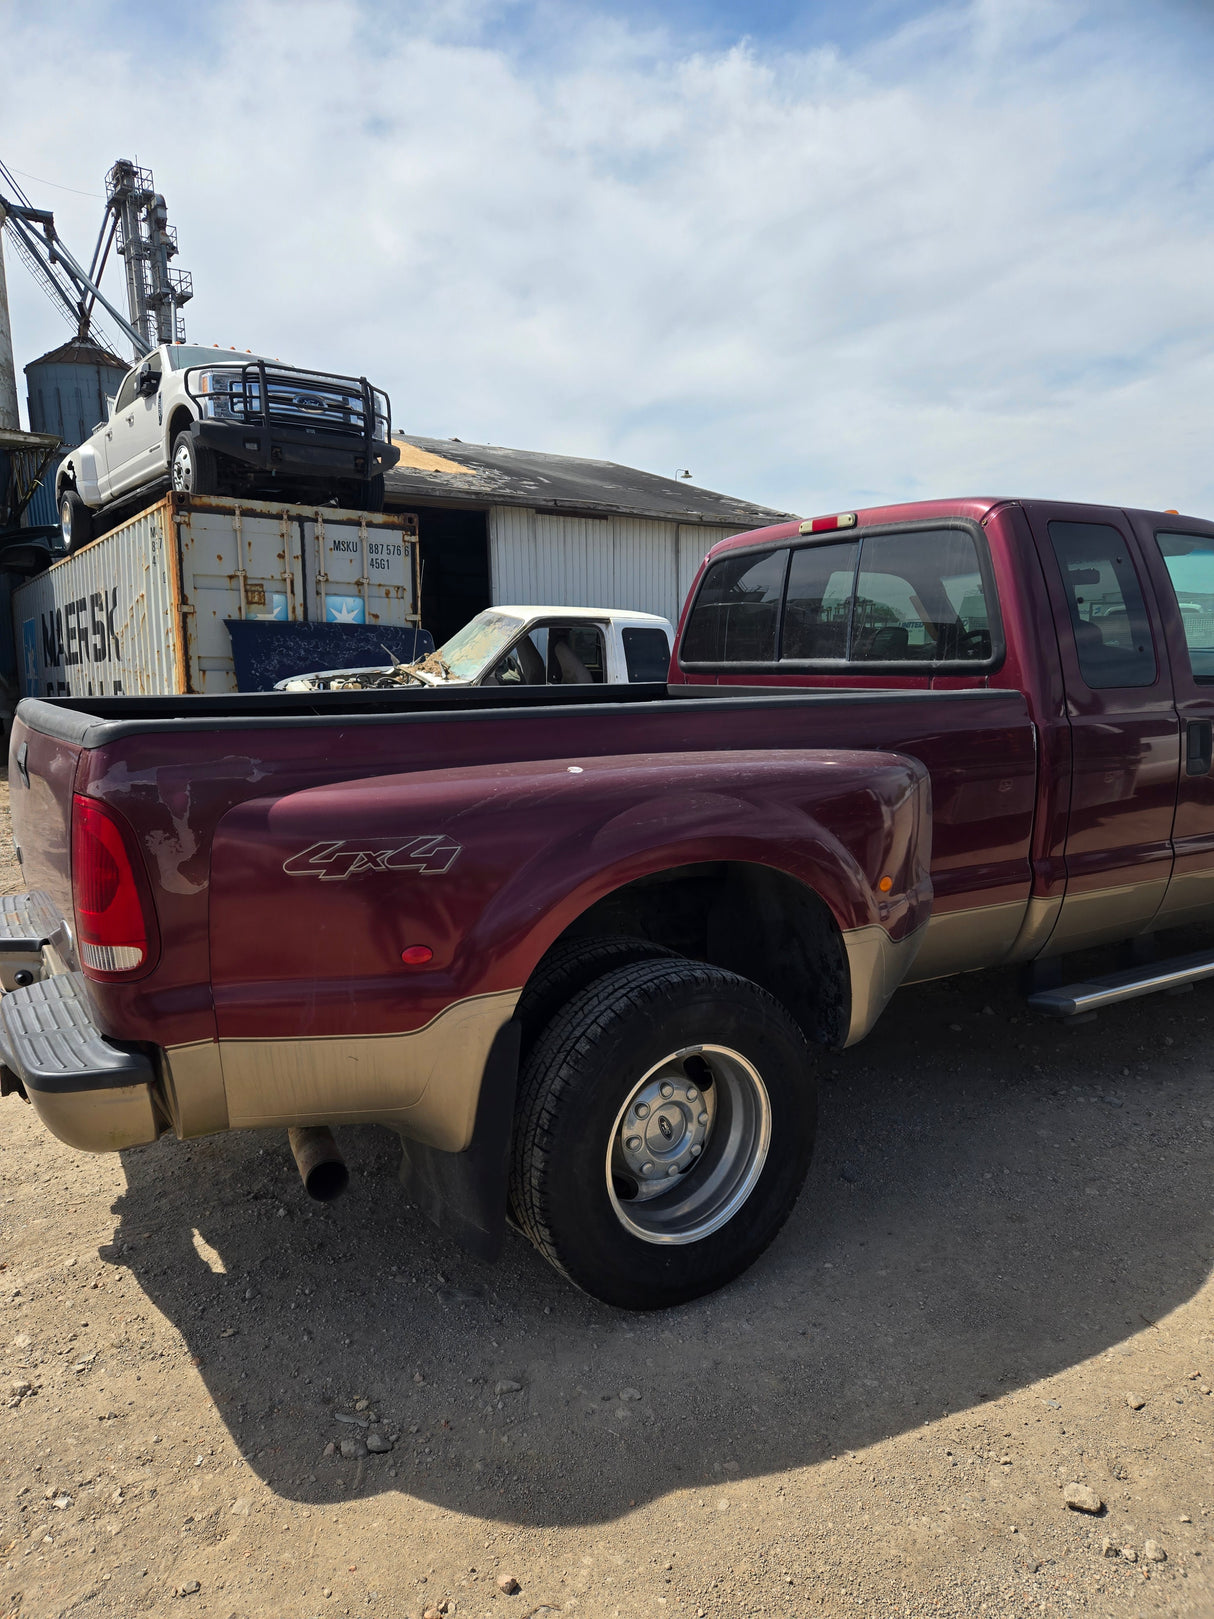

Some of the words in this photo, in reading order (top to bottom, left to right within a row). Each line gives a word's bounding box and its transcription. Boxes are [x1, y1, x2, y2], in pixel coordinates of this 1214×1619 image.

[333, 540, 358, 552] MSKU
[369, 543, 384, 555] 887
[386, 544, 402, 556] 576
[404, 545, 410, 556] 6
[369, 558, 390, 570] 45G1
[41, 586, 121, 668] MAERSK
[283, 834, 463, 881] 4x4
